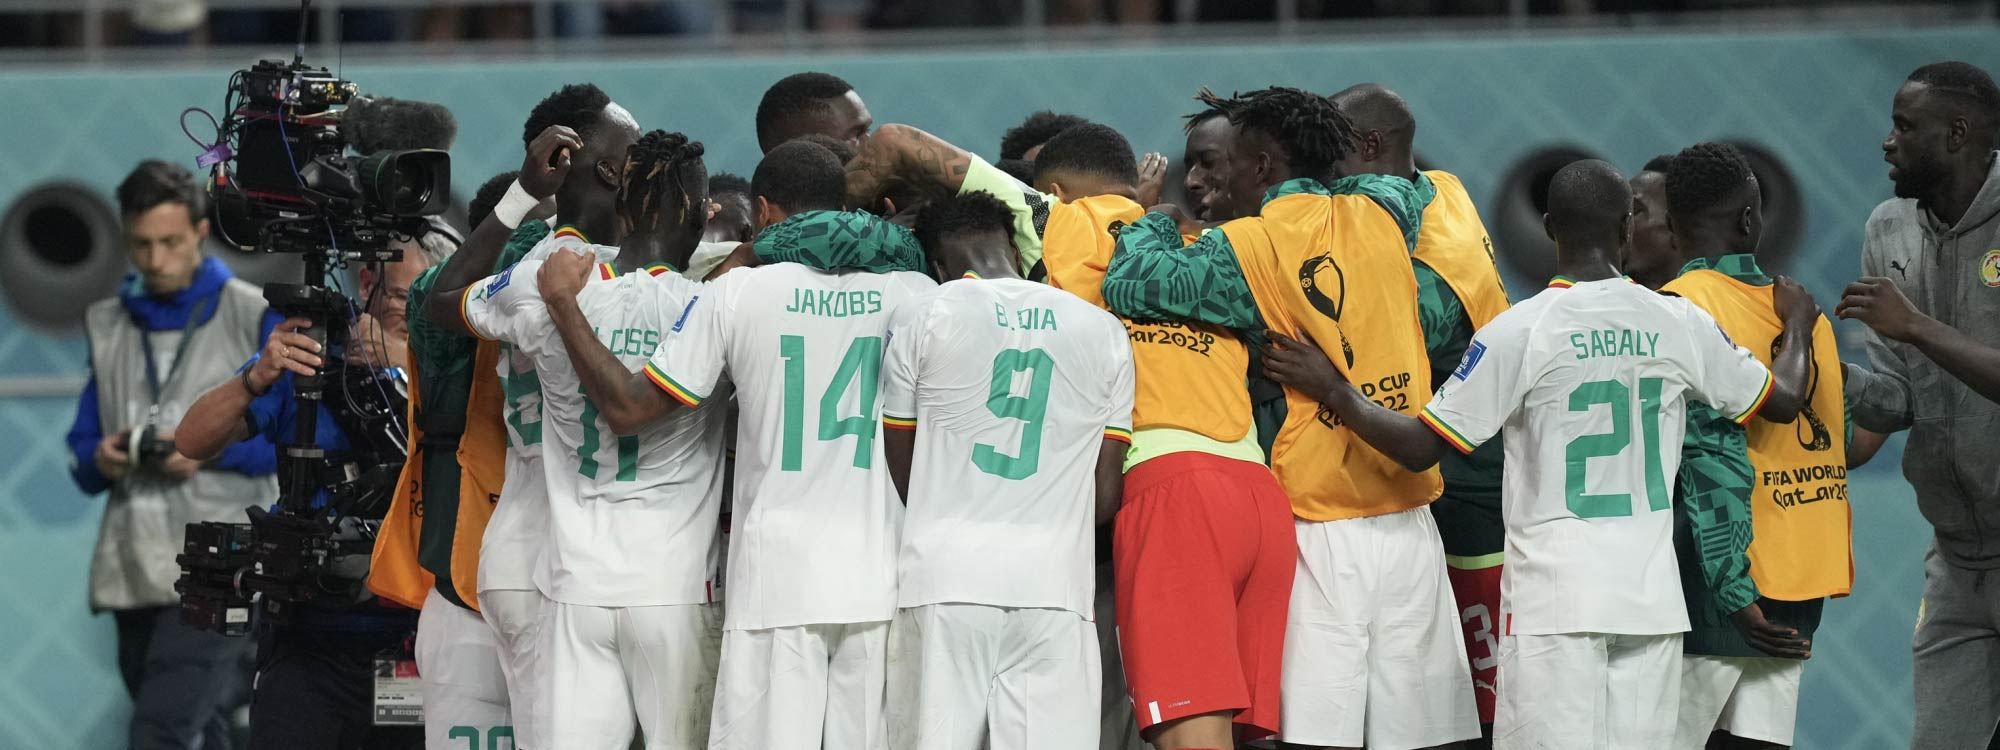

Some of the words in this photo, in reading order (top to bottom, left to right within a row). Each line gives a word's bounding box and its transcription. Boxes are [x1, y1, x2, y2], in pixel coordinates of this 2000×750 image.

[786, 288, 882, 317] JAKOBS
[1570, 329, 1660, 360] SABALY
[1379, 372, 1411, 393] CUP
[780, 334, 882, 471] 14
[971, 348, 1054, 481] 9
[1565, 377, 1671, 518] 21
[1763, 470, 1793, 486] FIFA
[1793, 465, 1846, 484] WORLD
